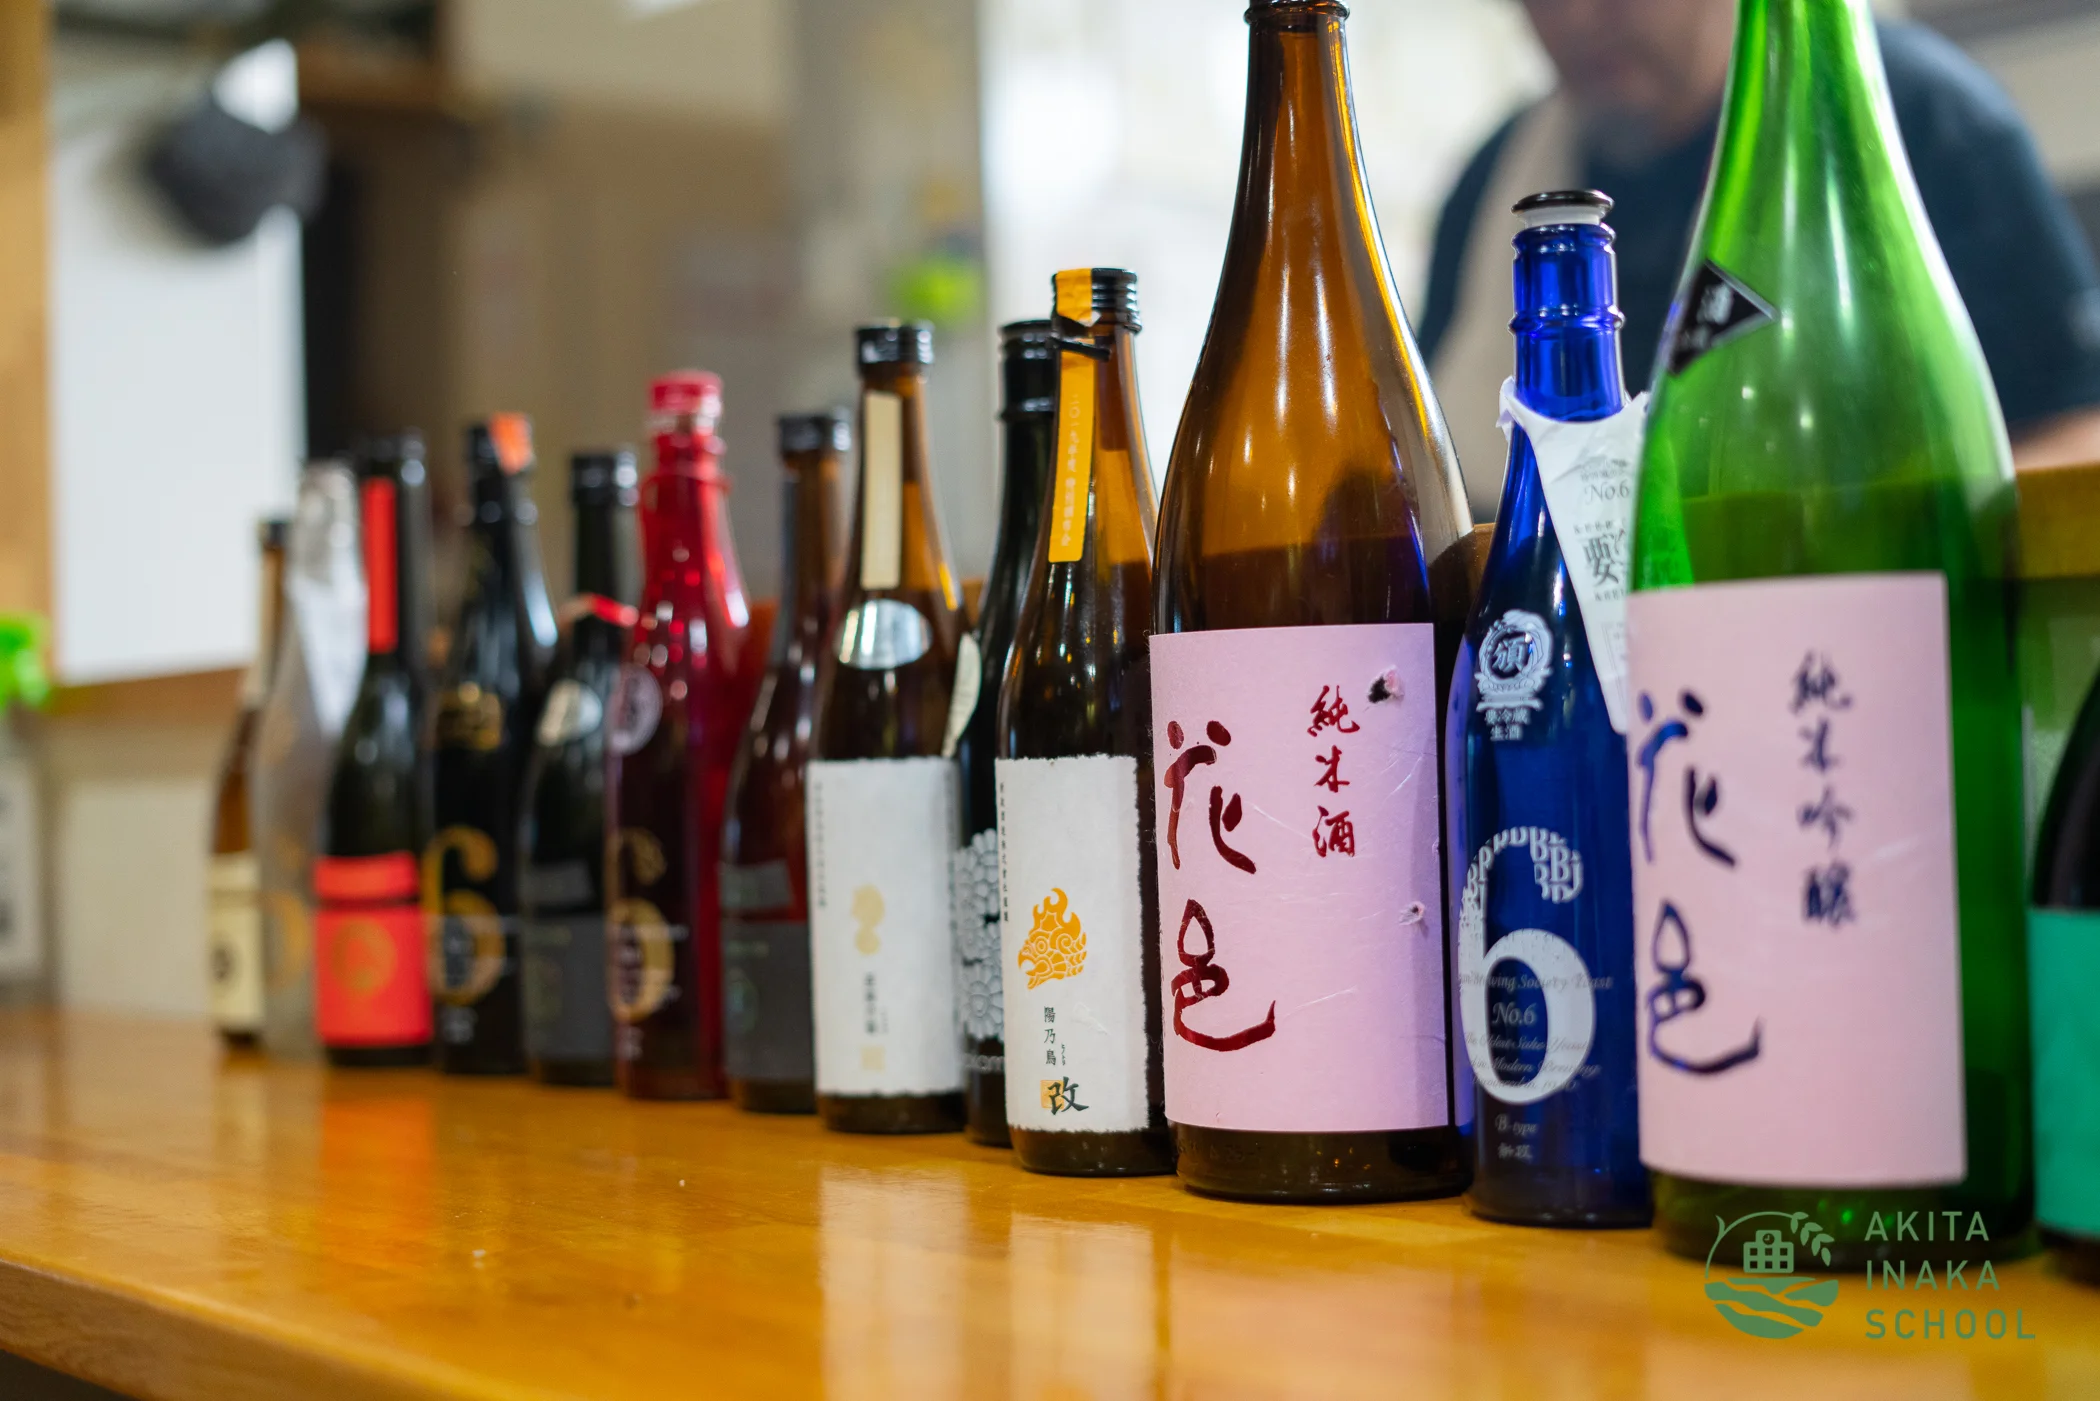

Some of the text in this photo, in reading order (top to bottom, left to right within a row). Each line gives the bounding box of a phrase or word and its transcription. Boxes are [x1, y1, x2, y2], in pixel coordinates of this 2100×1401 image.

[1584, 479, 1630, 506] No.6
[1306, 684, 1360, 857] 純米酒
[1788, 648, 1857, 928] 純米吟醸
[1165, 720, 1276, 1052] 花邑
[1458, 825, 1597, 1105] 6
[1491, 1001, 1538, 1027] No.6
[1043, 1006, 1057, 1066] 陽乃鳥
[1047, 1076, 1089, 1115] 改
